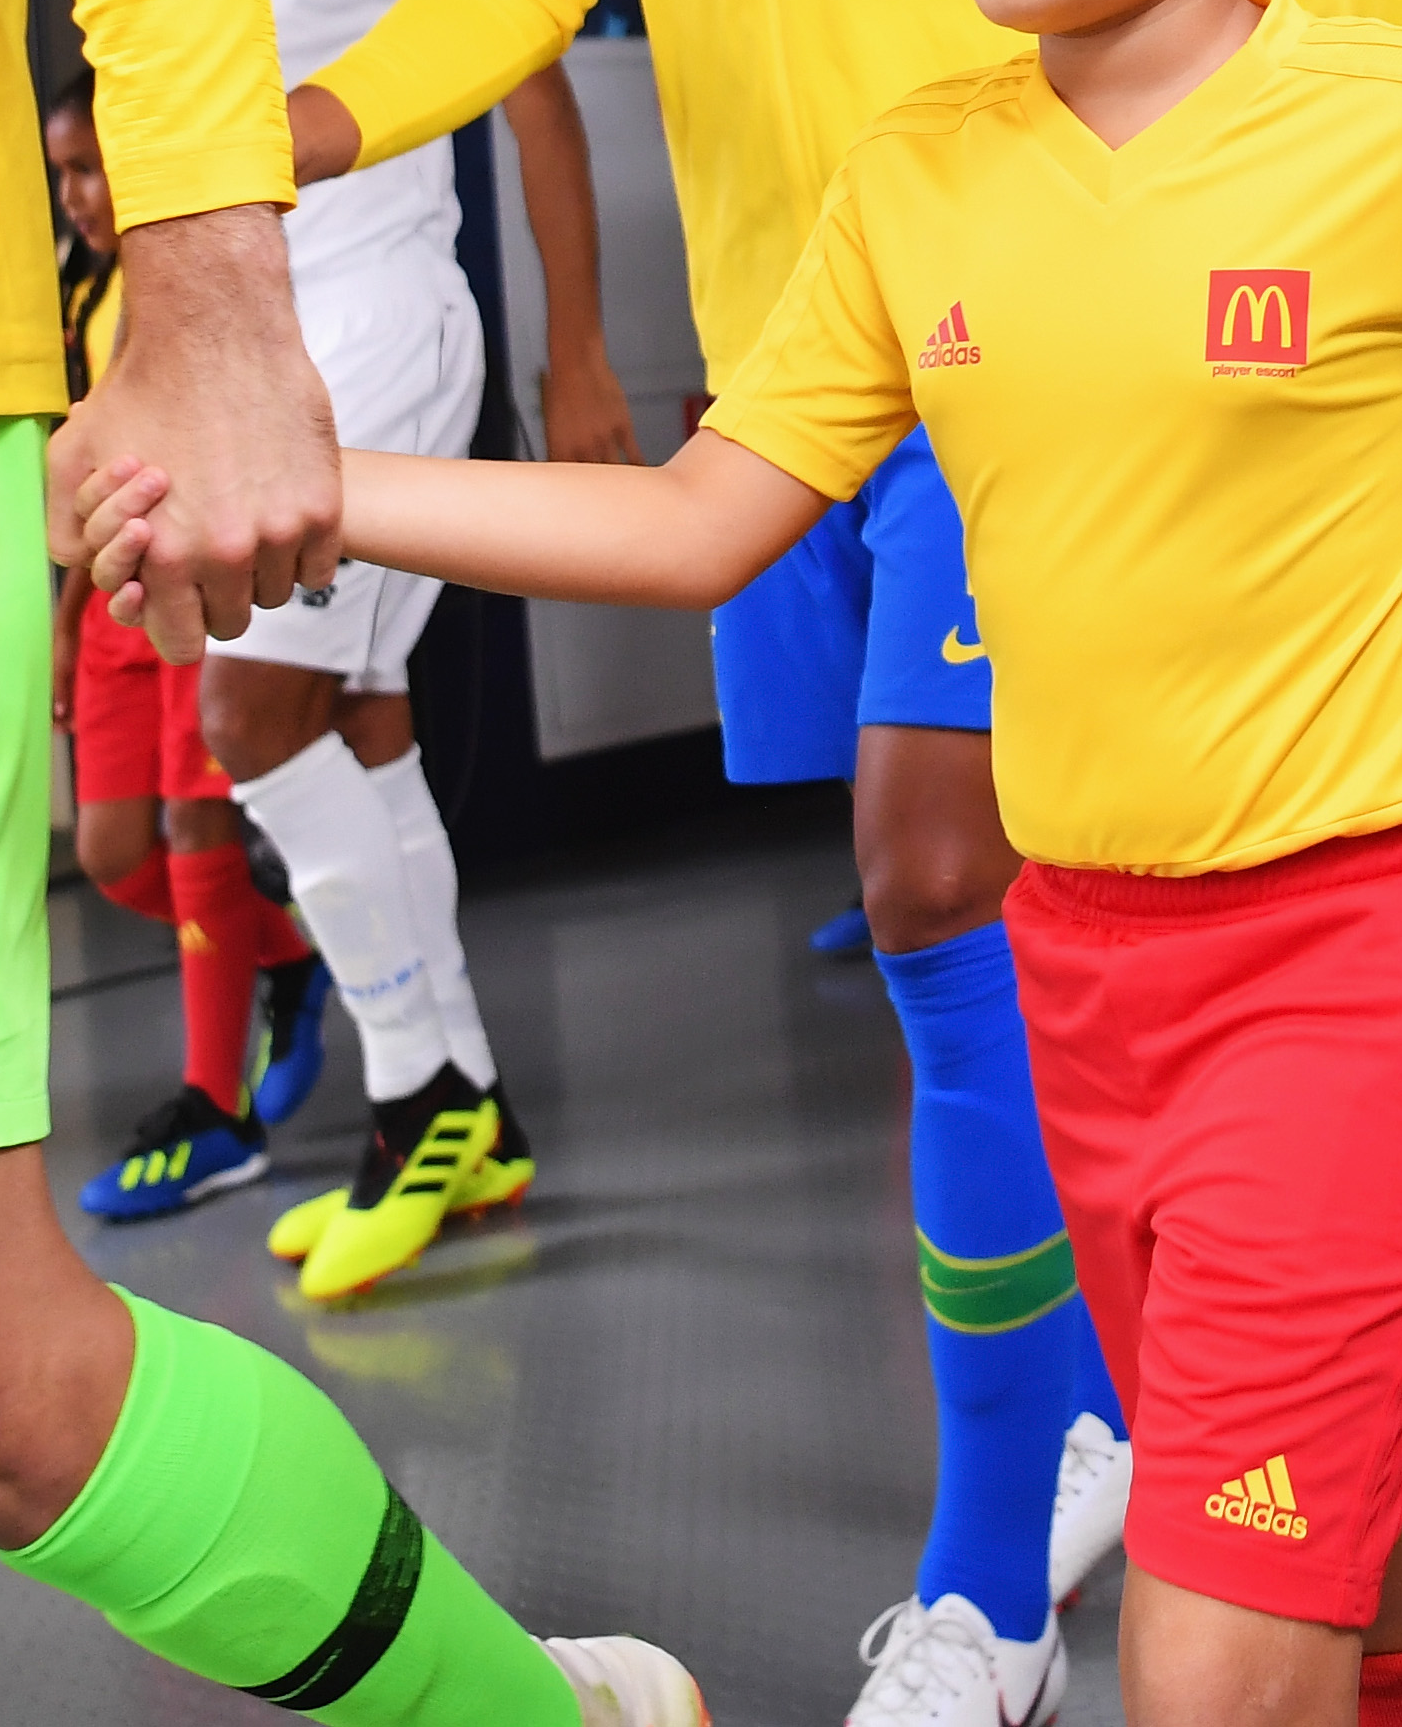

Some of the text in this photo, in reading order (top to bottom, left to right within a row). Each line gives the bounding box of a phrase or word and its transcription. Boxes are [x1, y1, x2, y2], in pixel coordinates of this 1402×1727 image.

[1221, 284, 1292, 348] M
[918, 342, 981, 370] adidas
[1212, 364, 1296, 378] player escort
[1204, 1493, 1309, 1540] adidas
